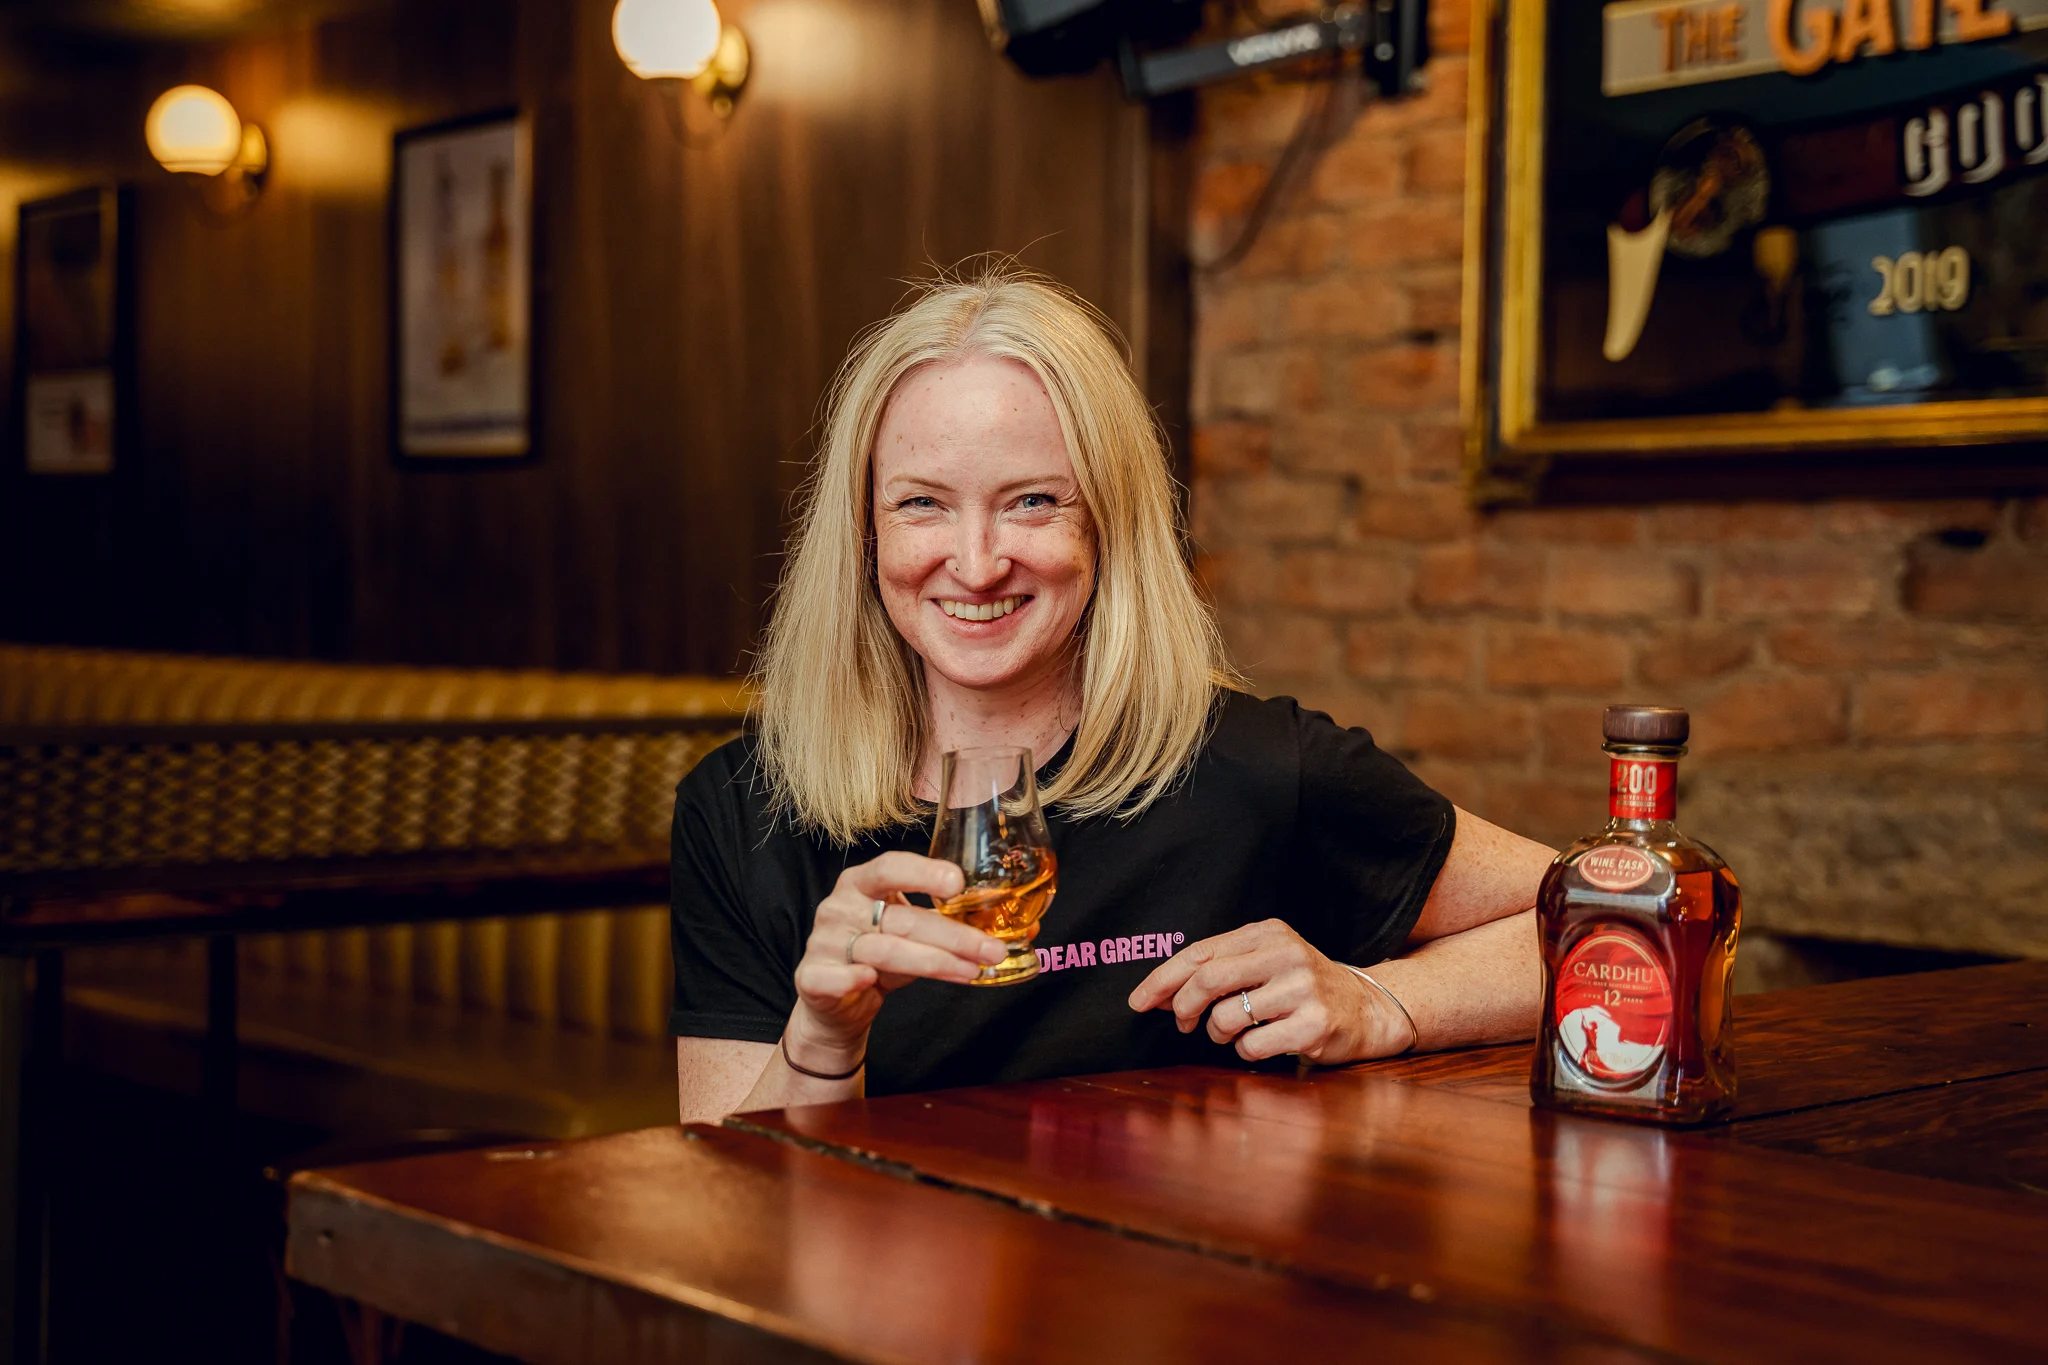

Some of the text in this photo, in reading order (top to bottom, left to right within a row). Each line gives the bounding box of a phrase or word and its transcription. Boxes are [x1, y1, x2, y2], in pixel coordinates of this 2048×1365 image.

[1656, 3, 1743, 72] THE
[1867, 245, 1971, 316] 2019
[1617, 763, 1657, 795] 200
[1590, 857, 1645, 872] WINE CASK
[1035, 942, 1096, 973] DEAR
[1574, 962, 1653, 983] CARDHU
[1603, 989, 1622, 1007] 12
